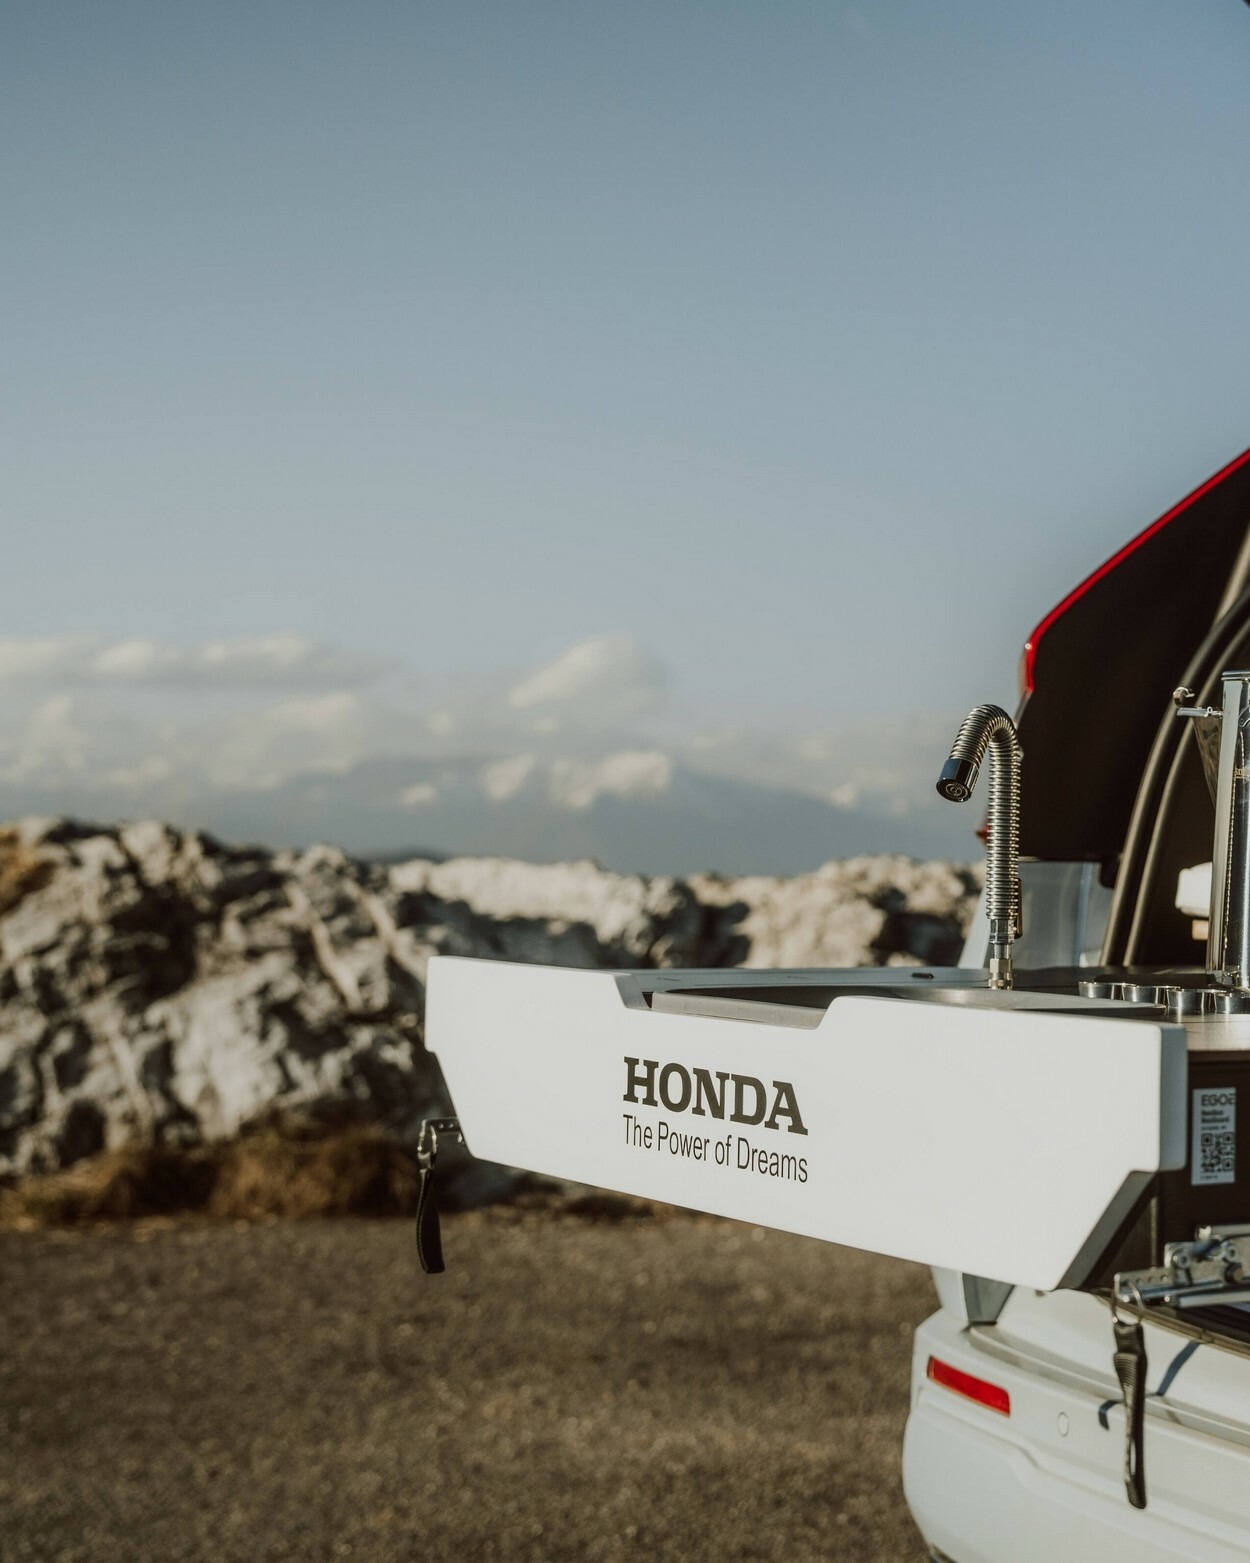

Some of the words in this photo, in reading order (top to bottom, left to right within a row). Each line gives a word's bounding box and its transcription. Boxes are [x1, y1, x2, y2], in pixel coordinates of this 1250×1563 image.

[623, 1056, 808, 1136] HONDA
[623, 1114, 653, 1150] The
[658, 1121, 710, 1162] Power
[715, 1135, 732, 1167] of
[737, 1137, 808, 1183] Dreams
